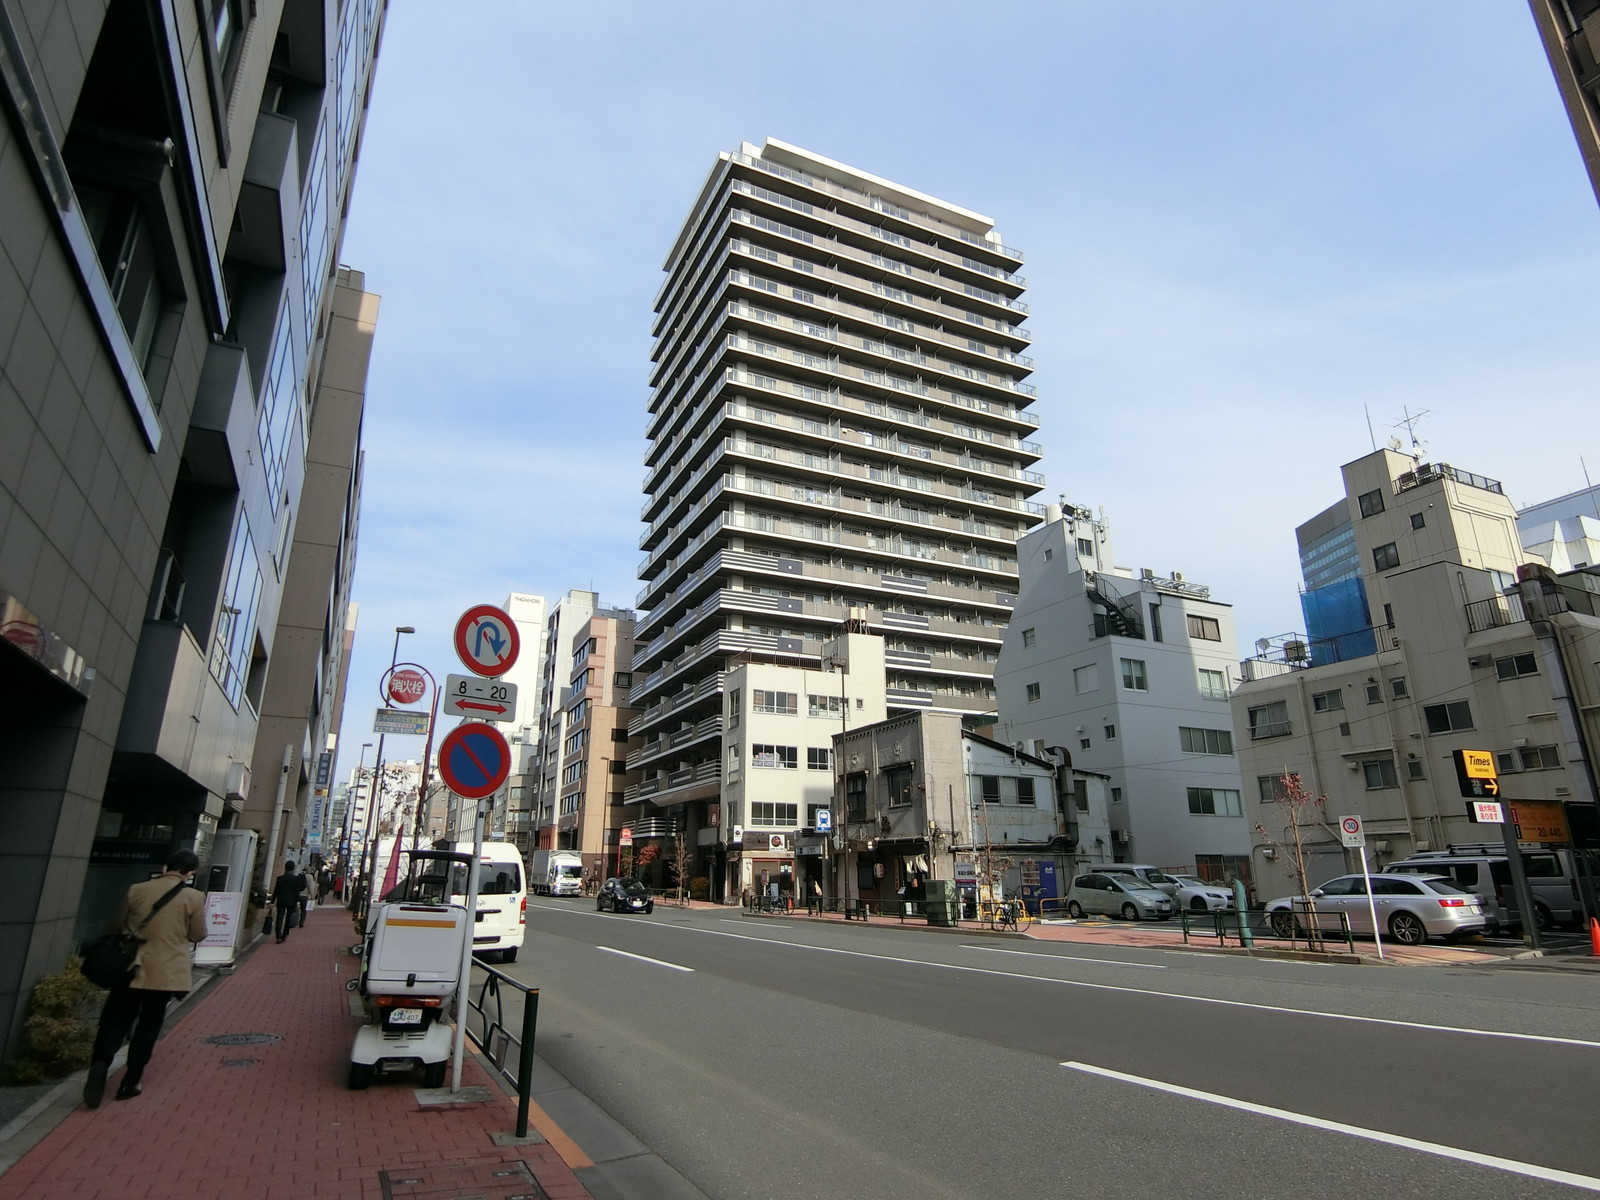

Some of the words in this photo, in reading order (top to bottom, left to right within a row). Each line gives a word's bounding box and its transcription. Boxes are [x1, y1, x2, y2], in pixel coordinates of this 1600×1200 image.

[391, 679, 424, 695] 消火栓
[490, 685, 508, 700] 20
[1469, 755, 1491, 766] Times
[311, 799, 322, 829] TUNTEX
[1478, 804, 1497, 812] 最大料金
[1346, 822, 1356, 830] 30
